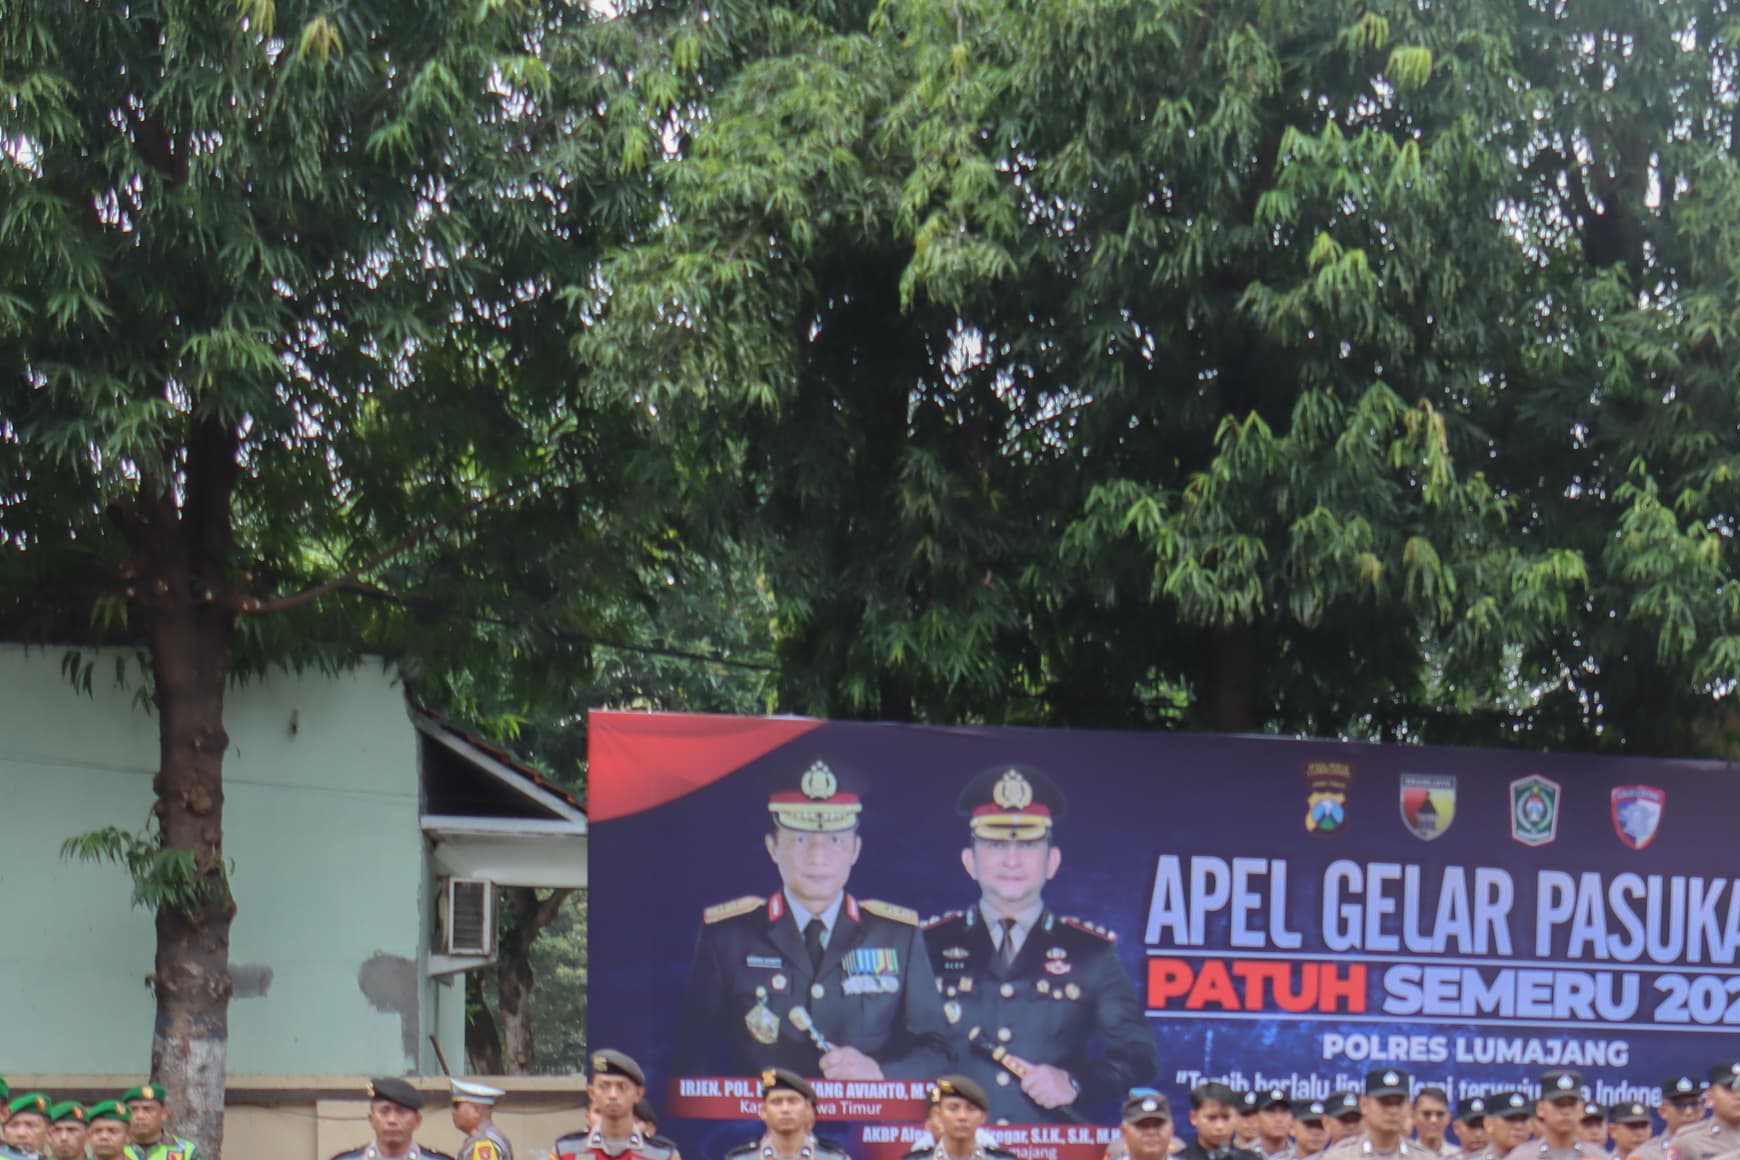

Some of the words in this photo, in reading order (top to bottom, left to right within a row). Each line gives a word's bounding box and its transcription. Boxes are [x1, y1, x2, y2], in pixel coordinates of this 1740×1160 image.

[1144, 854, 1303, 949] APEL
[1322, 859, 1514, 956] GELAR
[1148, 957, 1367, 1014] PATUH
[1382, 964, 1641, 1022] SEMERU
[1322, 1033, 1449, 1063] POLRES
[1456, 1037, 1630, 1068] LUMAJANG
[680, 1079, 722, 1097] IRJEN.
[725, 1080, 755, 1098] POL.
[846, 1081, 908, 1101] AVIANTO,
[841, 1100, 882, 1115] Timur
[863, 1126, 899, 1143] AKBP
